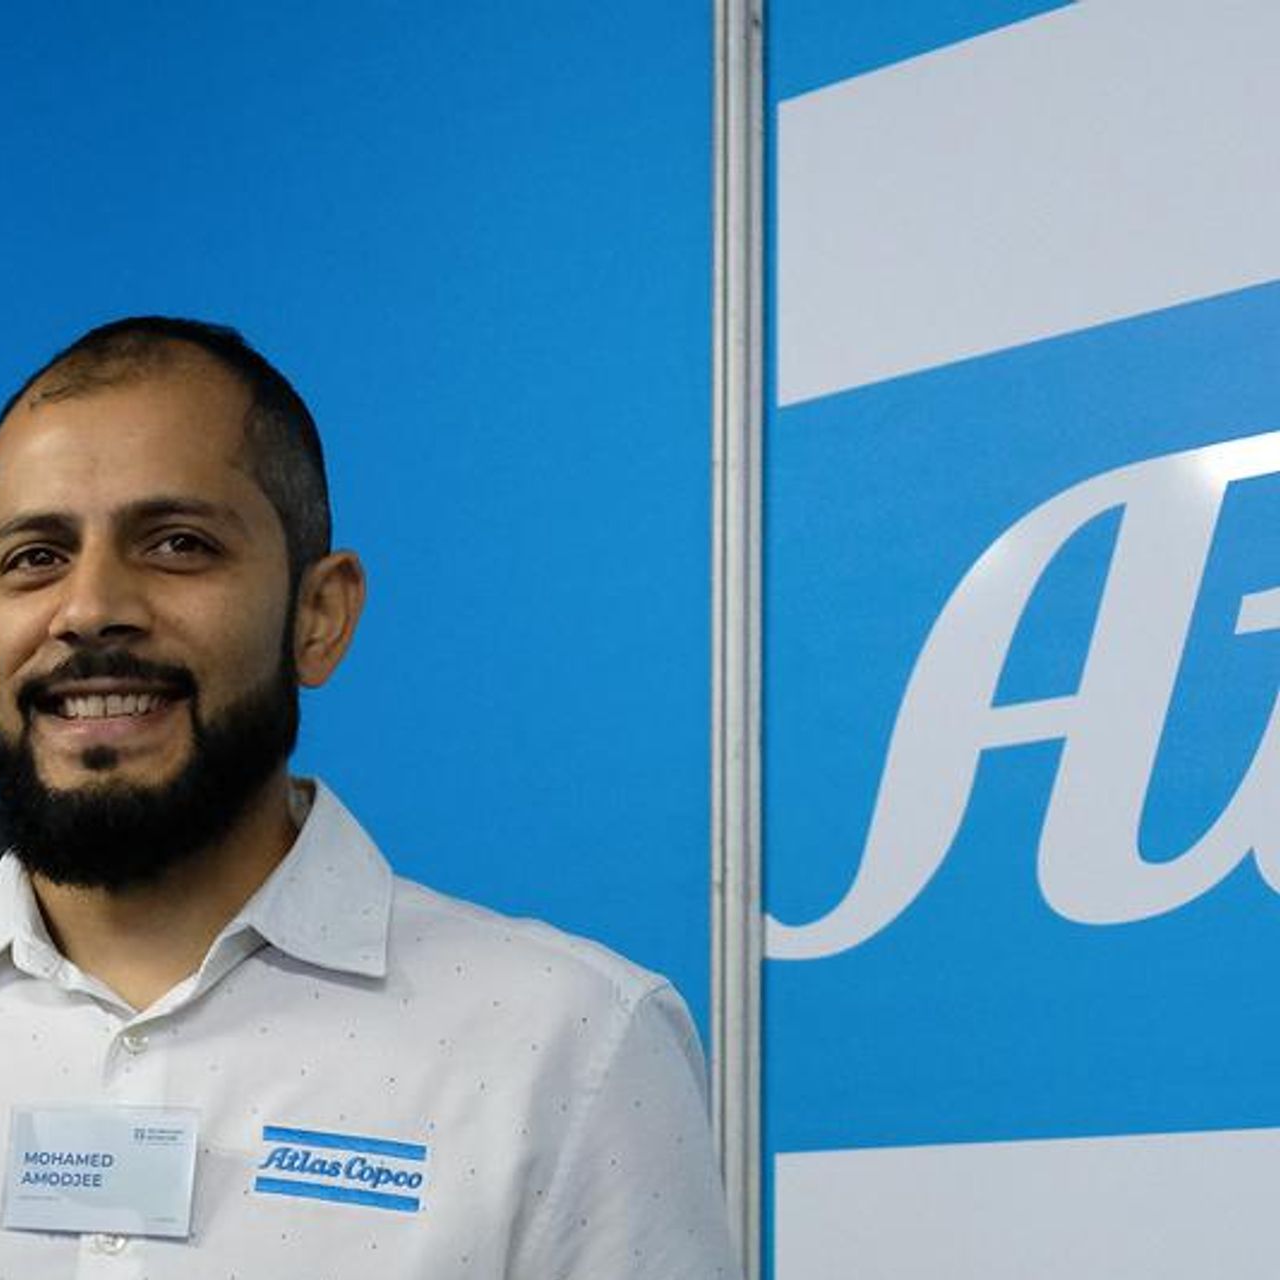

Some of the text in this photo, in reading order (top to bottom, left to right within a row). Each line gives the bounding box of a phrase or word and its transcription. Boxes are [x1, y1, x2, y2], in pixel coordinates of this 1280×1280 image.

[24, 1151, 114, 1168] MOHAMED
[259, 1146, 424, 1189] Atlas Copco
